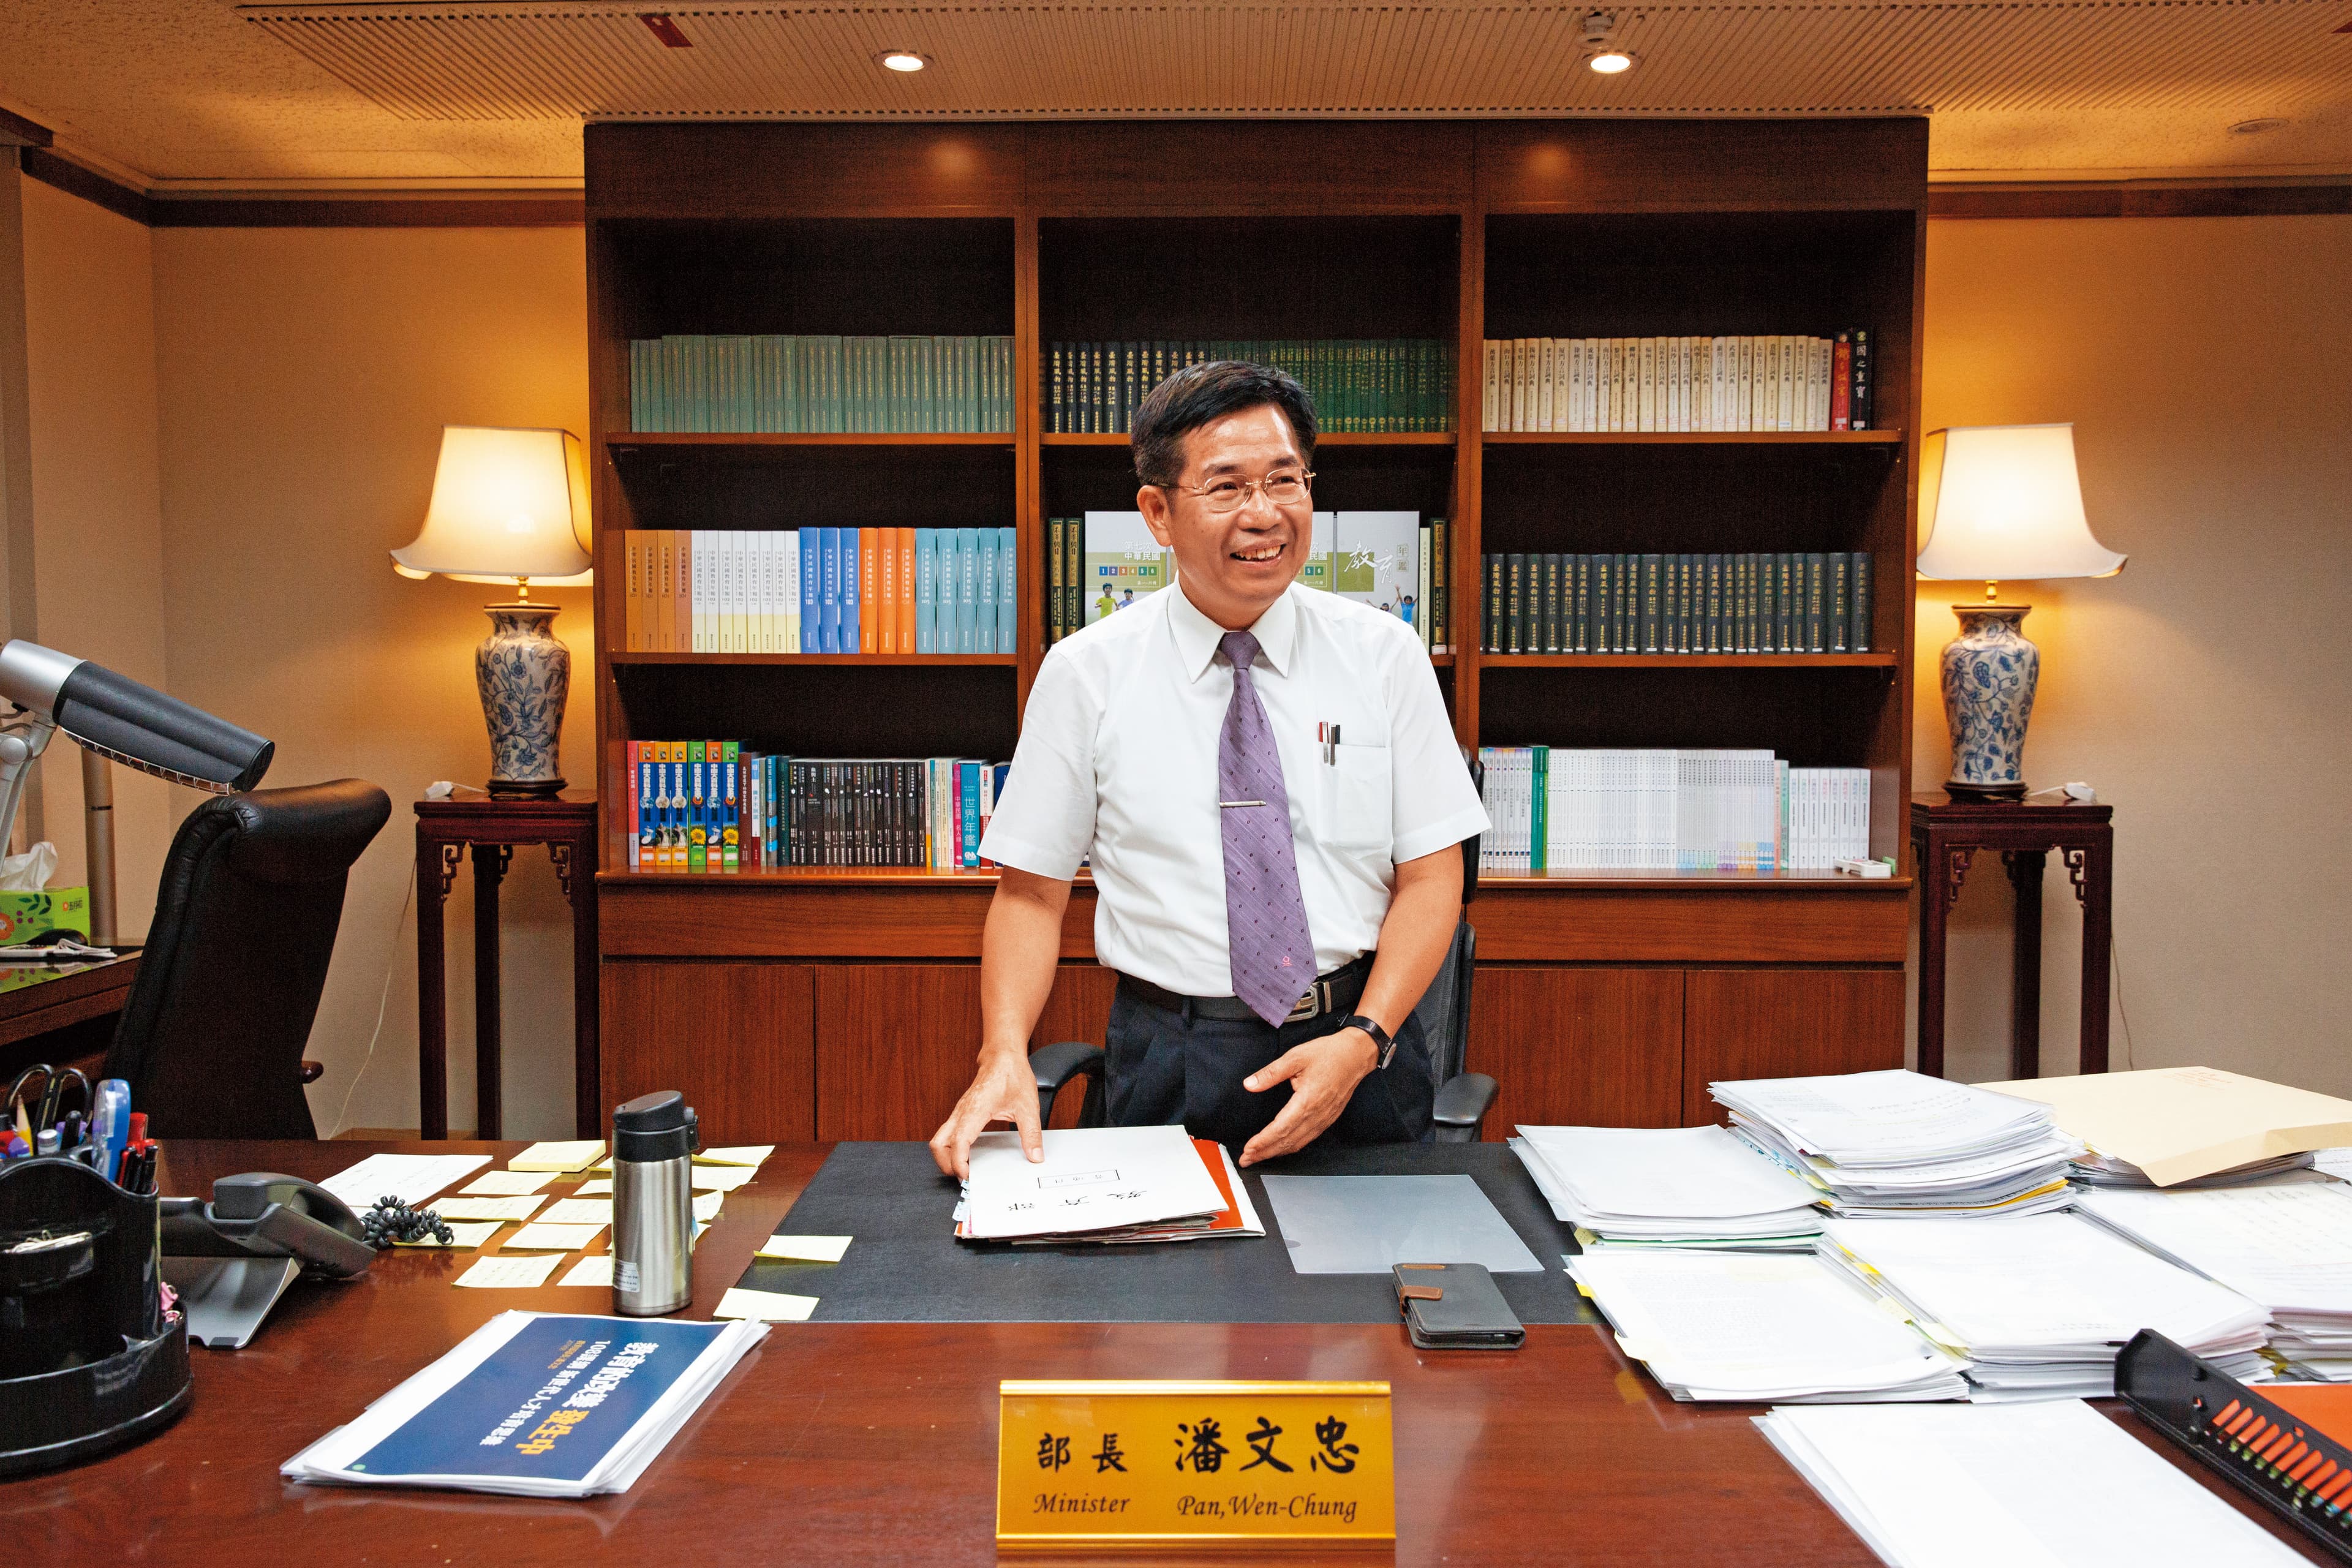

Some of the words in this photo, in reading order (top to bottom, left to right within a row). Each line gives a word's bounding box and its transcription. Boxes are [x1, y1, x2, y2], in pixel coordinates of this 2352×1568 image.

[1125, 541, 1152, 551] 第七次
[1125, 552, 1160, 561] 中華民國
[1344, 540, 1393, 583] 教育
[964, 797, 976, 846] 世界年鑑
[562, 1342, 659, 1408] 教育的改變
[567, 1340, 611, 1370] 108課綱
[479, 1370, 581, 1446] 新世代人才培育思維
[516, 1409, 590, 1455] 發生中
[1037, 1432, 1128, 1474] 部長
[1174, 1415, 1360, 1474] 潘文忠
[1033, 1493, 1131, 1513] Minister
[1177, 1493, 1357, 1524] Pan,Wen-Chung
